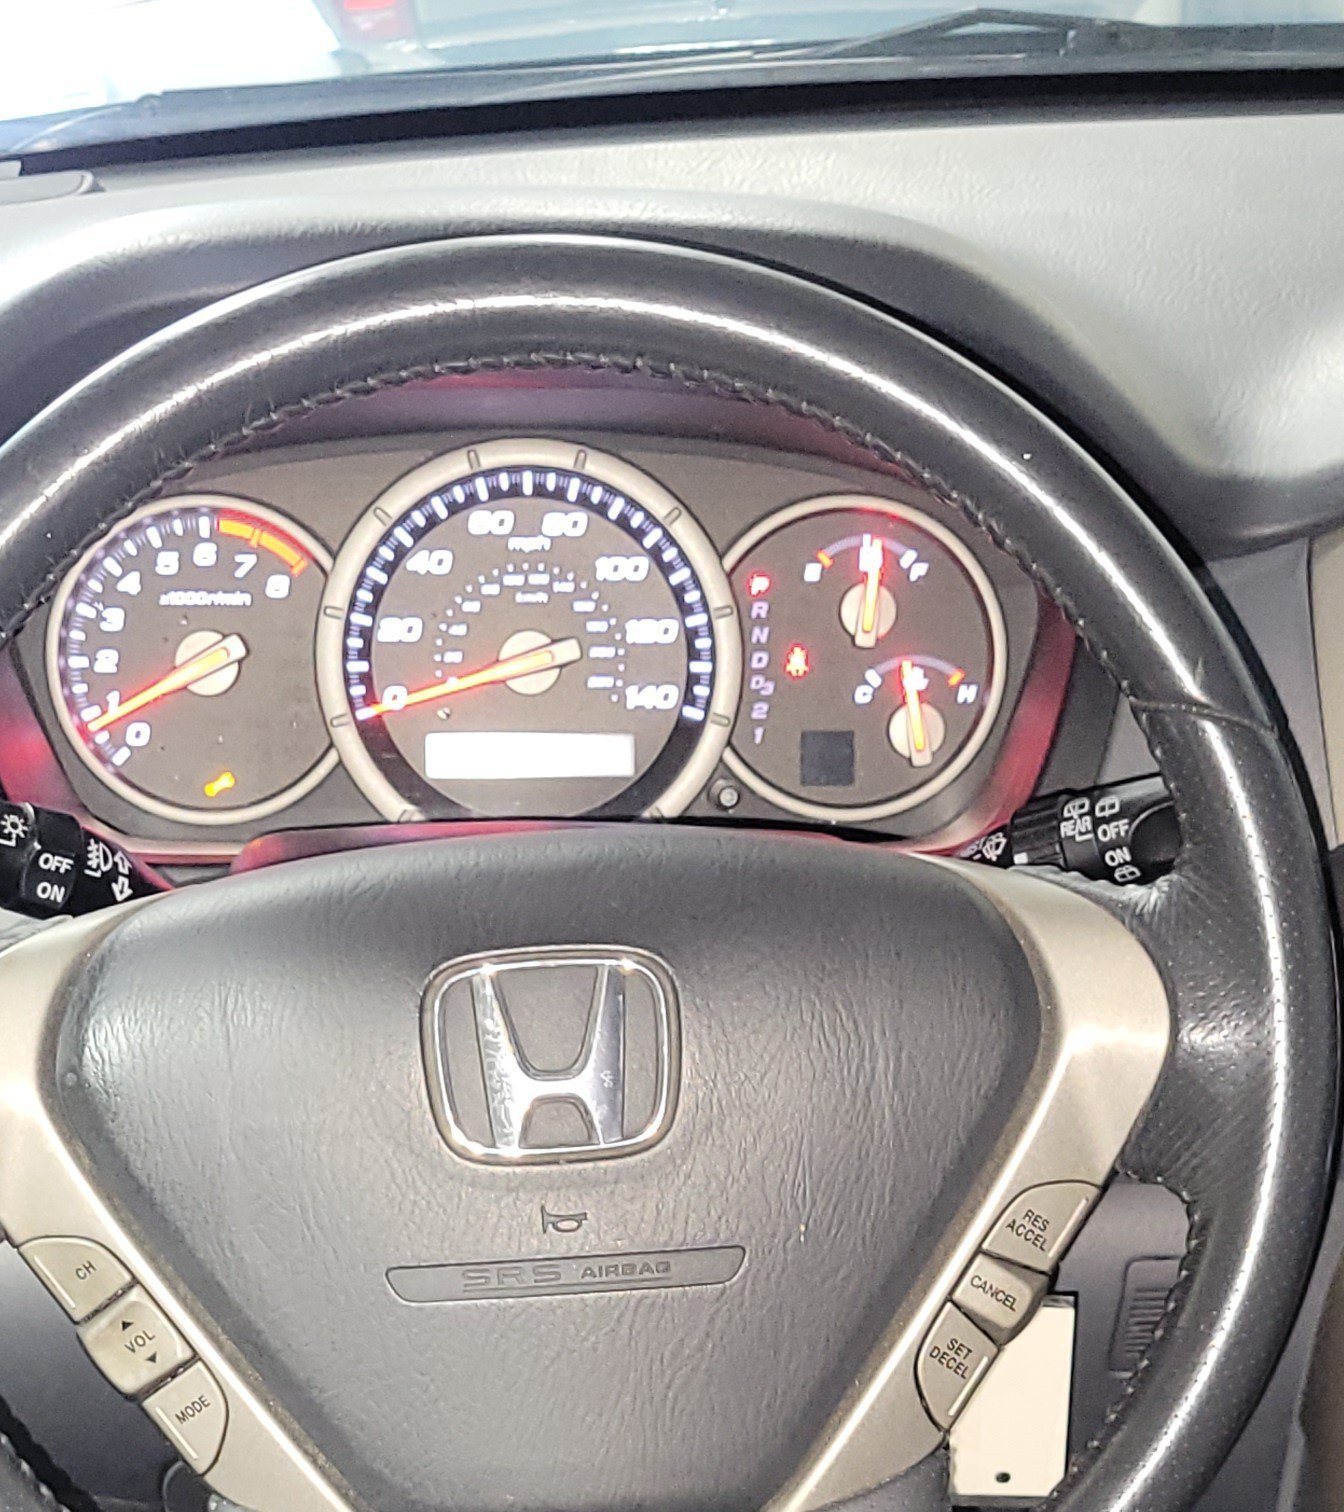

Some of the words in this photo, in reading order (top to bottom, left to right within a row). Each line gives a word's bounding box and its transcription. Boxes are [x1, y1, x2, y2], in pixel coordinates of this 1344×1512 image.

[468, 510, 514, 535] 60
[542, 511, 588, 536] 80
[155, 551, 179, 575] 5
[193, 542, 217, 566] 6
[234, 553, 257, 578] 7
[406, 550, 453, 574] 40
[594, 556, 649, 581] 100
[909, 562, 929, 582] F
[116, 571, 141, 595] 4
[265, 574, 290, 598] 8
[750, 574, 770, 595] P
[99, 607, 125, 631] 3
[750, 602, 769, 618] R
[750, 626, 769, 644] N
[93, 649, 119, 673] 2
[750, 651, 769, 669] D
[382, 685, 407, 709] 0
[625, 685, 679, 709] 140
[854, 684, 873, 704] C
[957, 684, 978, 703] H
[751, 702, 769, 720] 2
[125, 722, 151, 746] 0
[754, 727, 766, 745] 1
[1060, 816, 1093, 838] REAR
[1097, 819, 1129, 842] OFF
[38, 853, 74, 874] OFF
[1105, 847, 1131, 867] ON
[36, 882, 66, 902] ON
[1023, 1209, 1049, 1232] RES
[1006, 1219, 1049, 1252] ACCEL
[75, 1260, 96, 1280] CH
[463, 1264, 561, 1288] SRS
[581, 1261, 671, 1280] AIRBAG
[970, 1275, 1017, 1312] CANCEL
[124, 1330, 156, 1354] VOL
[946, 1338, 973, 1361] SET
[929, 1346, 968, 1380] DECEL
[174, 1395, 211, 1425] MODE
